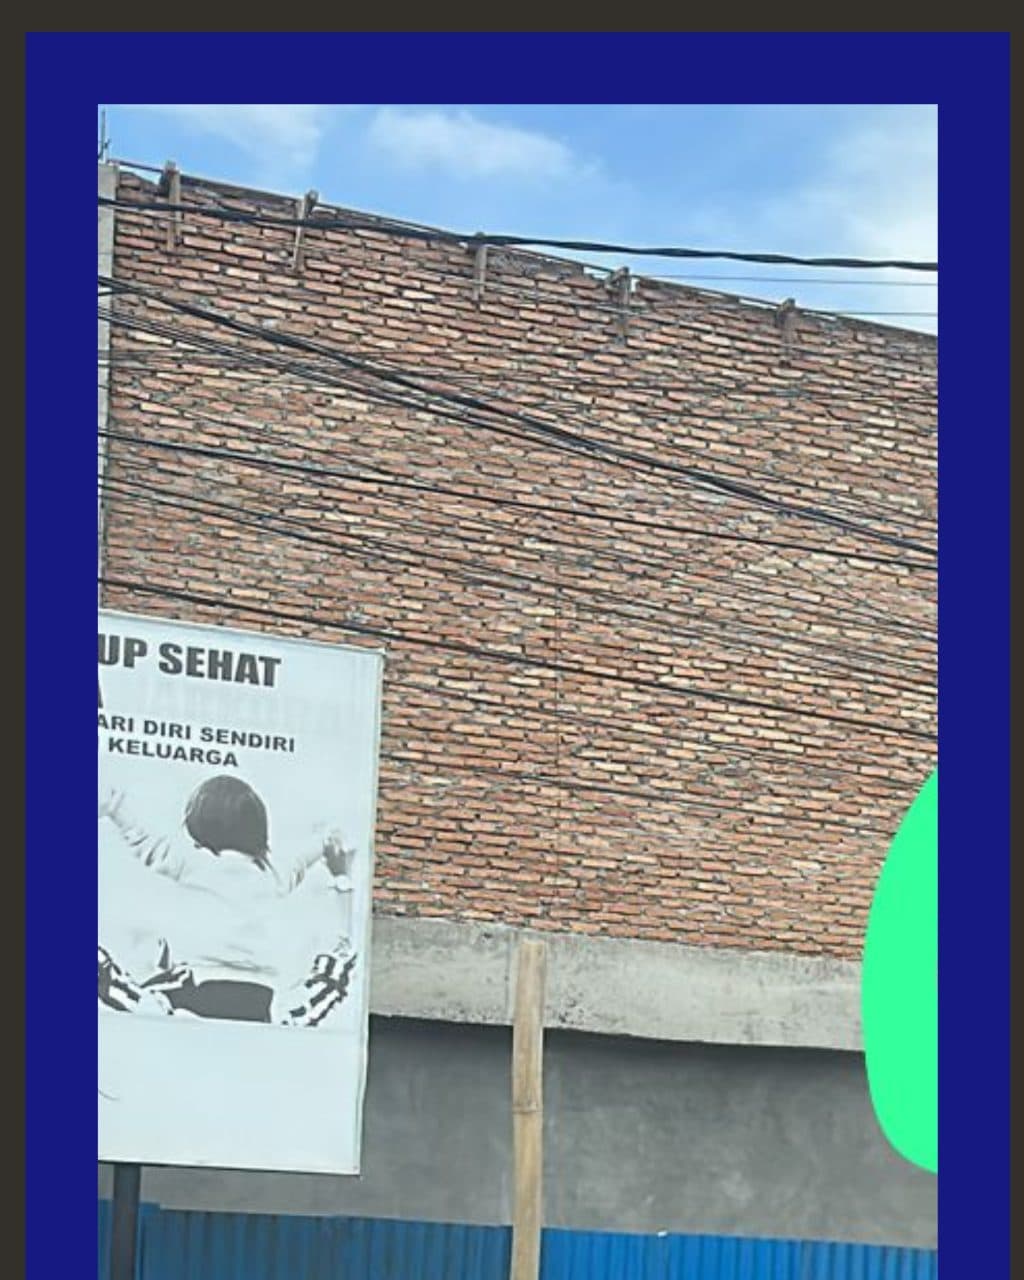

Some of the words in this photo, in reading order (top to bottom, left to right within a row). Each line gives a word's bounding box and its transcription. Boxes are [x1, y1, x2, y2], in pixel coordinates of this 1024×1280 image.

[159, 643, 282, 687] SEHAT
[109, 737, 238, 767] KELUARGA
[144, 720, 191, 740] DIRI
[201, 728, 295, 752] SENDIRI
